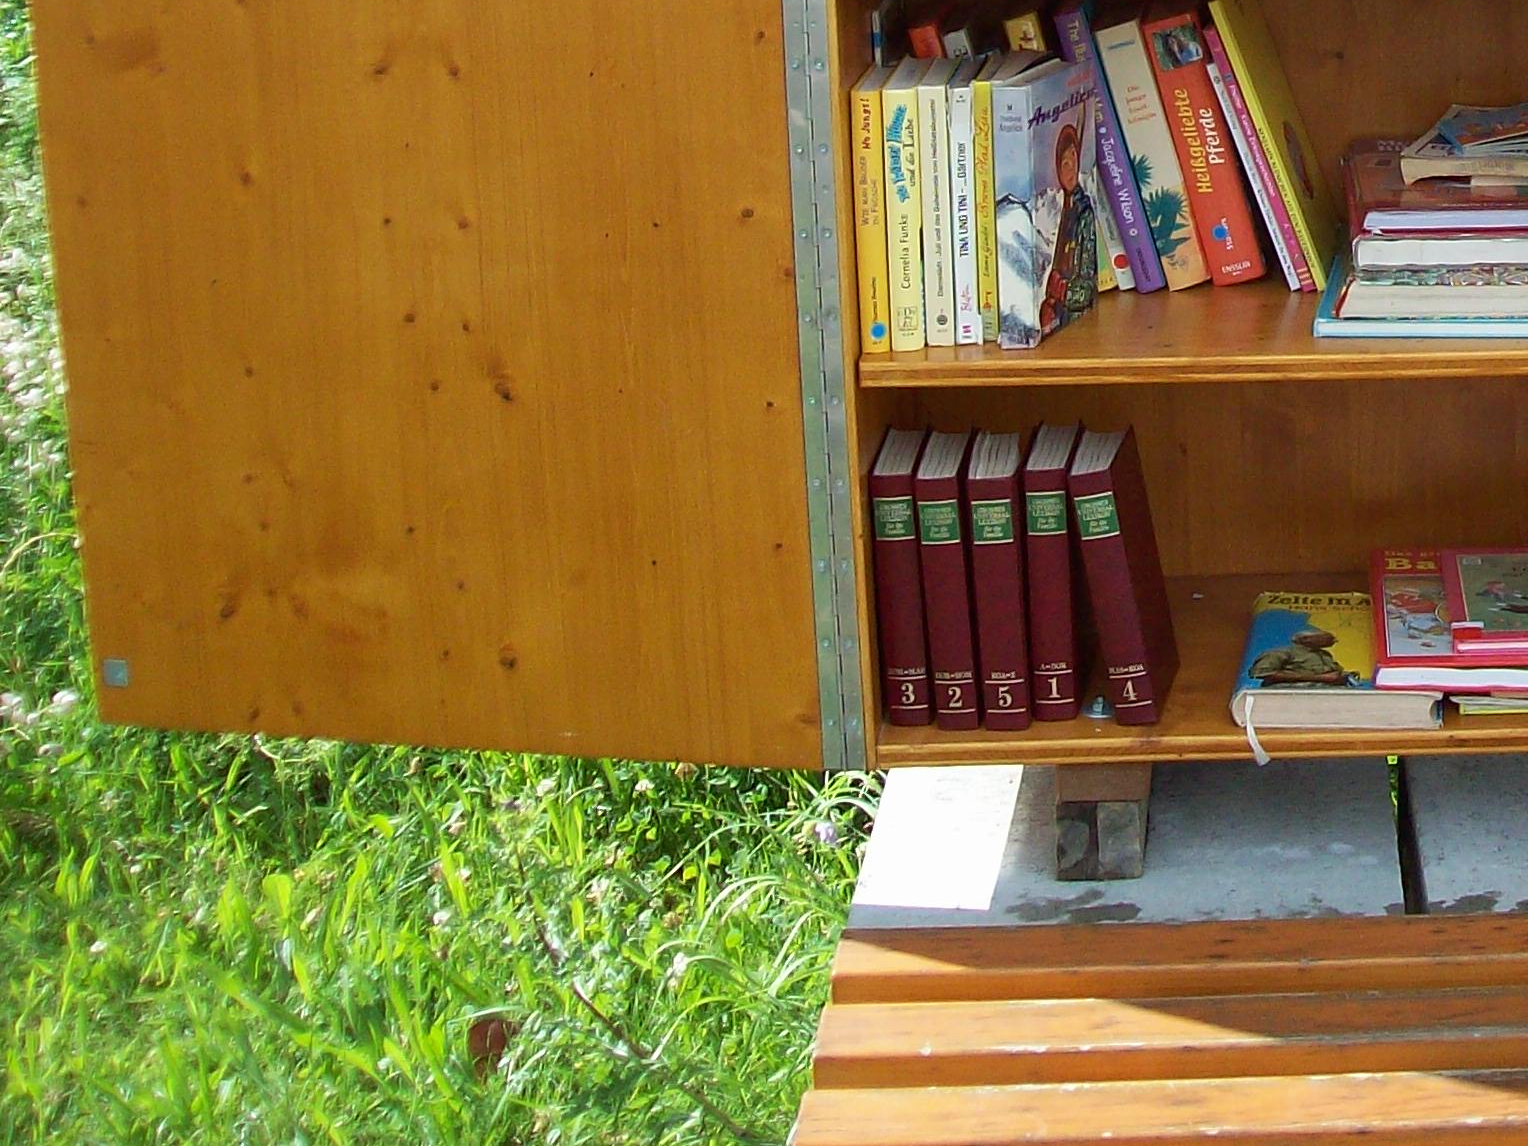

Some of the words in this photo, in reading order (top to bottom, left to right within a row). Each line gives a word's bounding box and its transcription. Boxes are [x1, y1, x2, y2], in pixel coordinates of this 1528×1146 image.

[1173, 88, 1213, 193] Heißgeliebte
[1198, 108, 1226, 165] Pferde
[1115, 188, 1134, 224] Wilson
[899, 213, 909, 243] Funke
[899, 247, 911, 289] Cornelia
[901, 682, 915, 704] 3
[948, 686, 963, 708] 2
[998, 685, 1013, 707] 5
[1048, 677, 1061, 699] 1
[1122, 680, 1138, 701] 4
